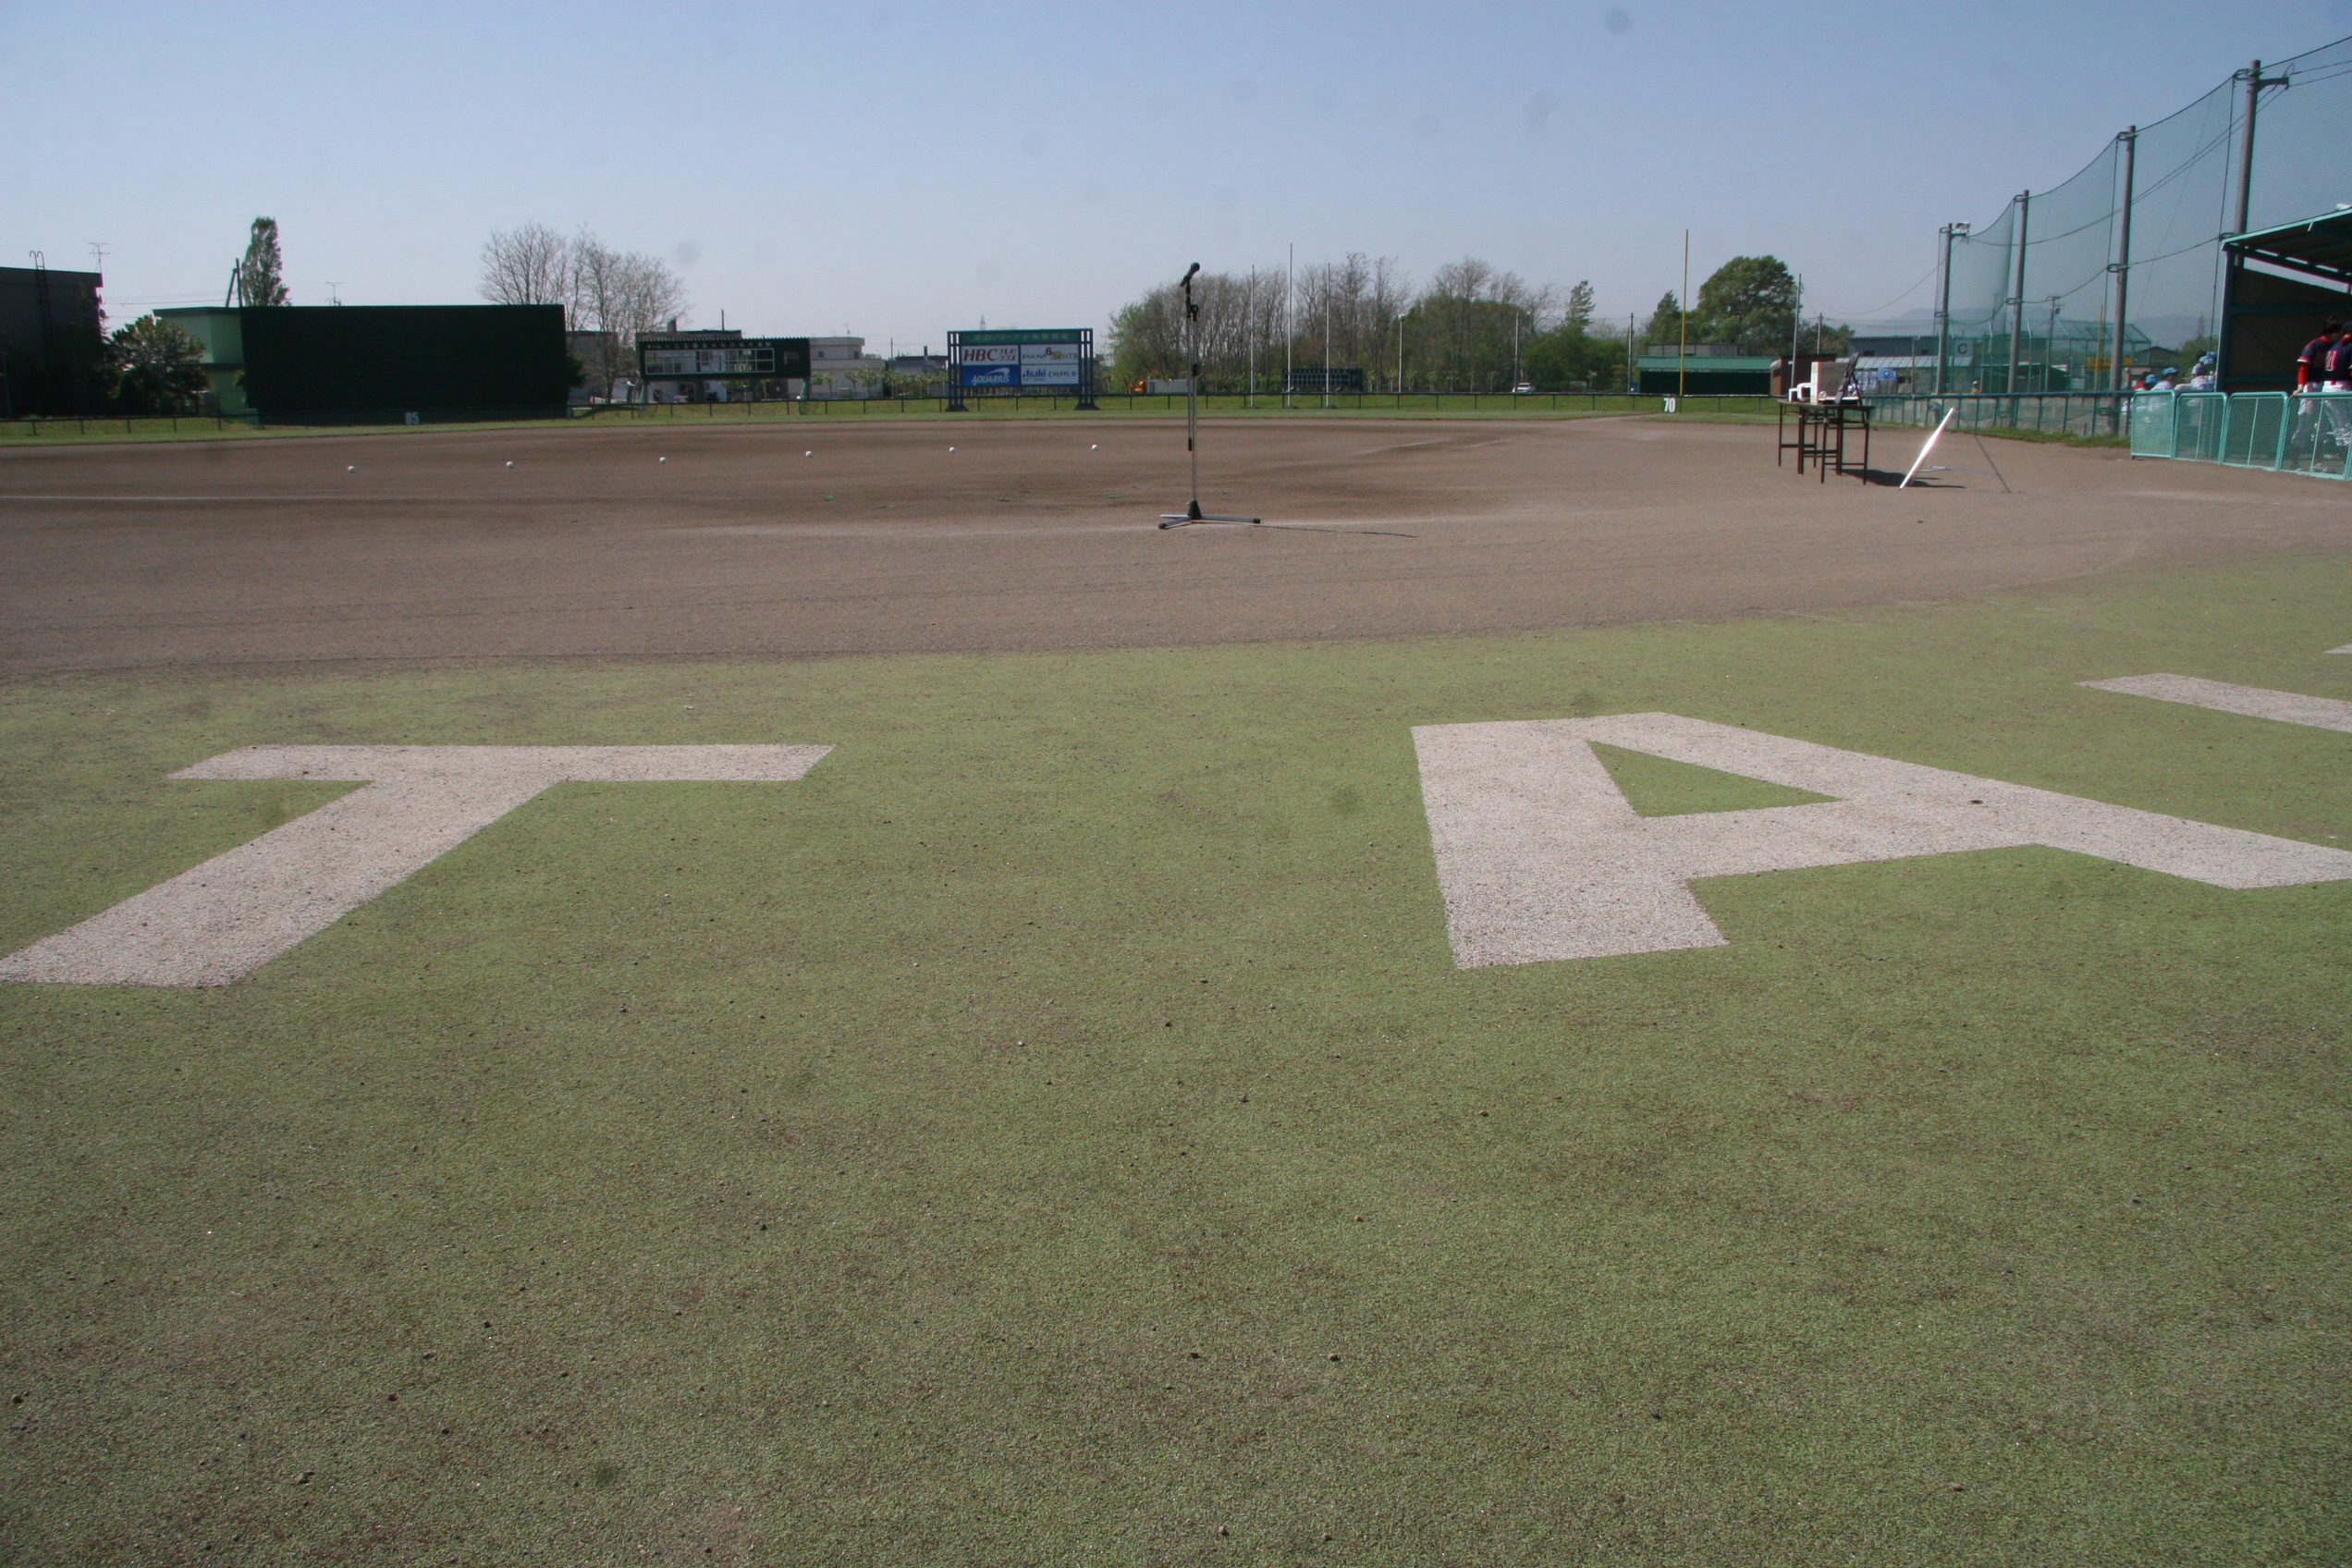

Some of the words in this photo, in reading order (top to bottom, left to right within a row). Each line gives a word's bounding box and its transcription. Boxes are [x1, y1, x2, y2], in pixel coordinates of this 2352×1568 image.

[963, 349, 998, 361] HBC
[1957, 343, 1967, 355] C
[1023, 368, 1047, 378] Asahi
[972, 374, 1010, 385] AQUARIUS
[1663, 398, 1676, 413] 70
[405, 411, 420, 425] 85
